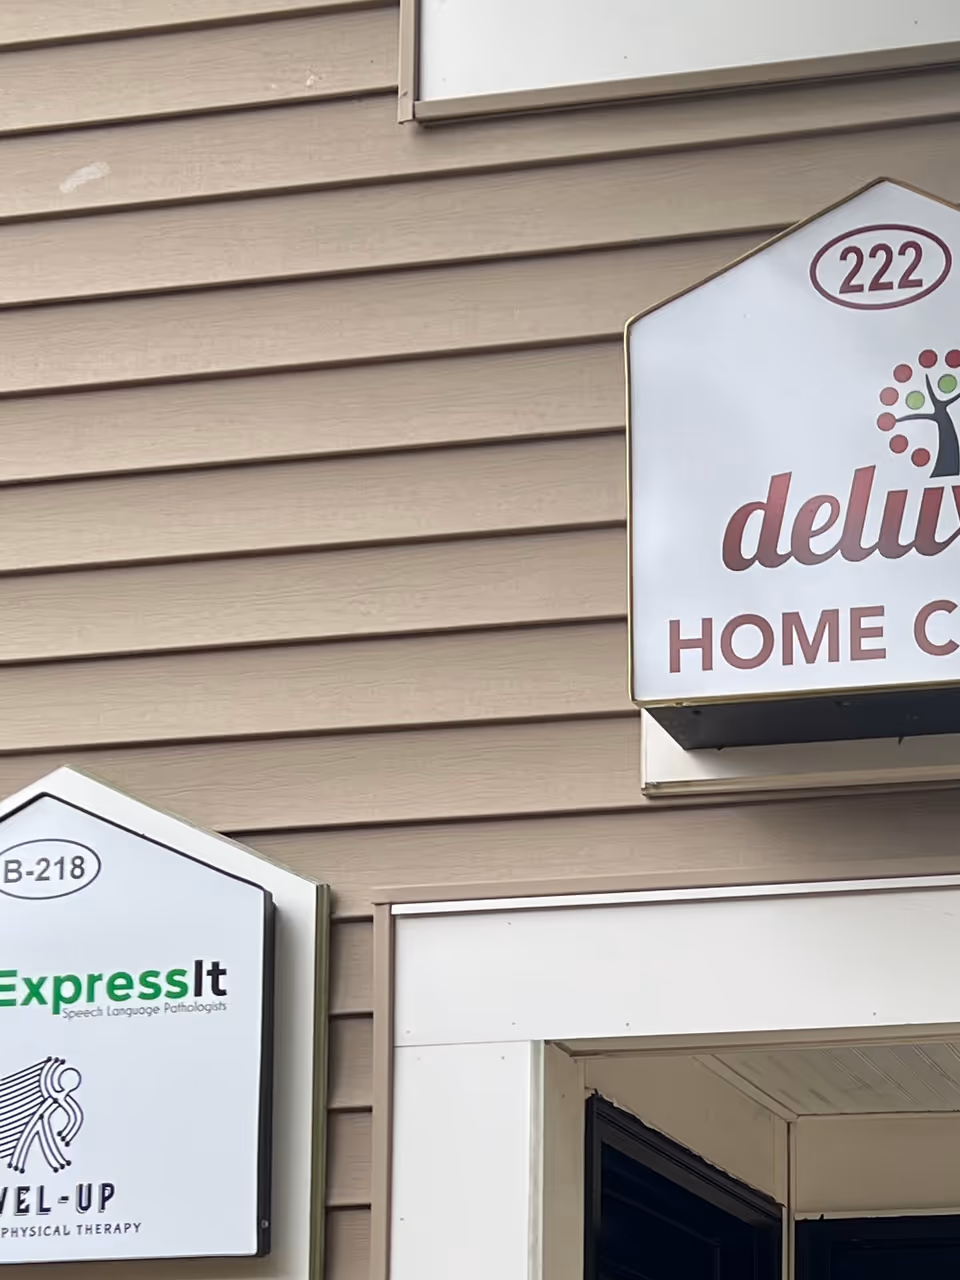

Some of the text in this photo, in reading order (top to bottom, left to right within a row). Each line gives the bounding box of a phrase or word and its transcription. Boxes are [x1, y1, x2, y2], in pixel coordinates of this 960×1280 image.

[838, 240, 924, 295] 222
[668, 605, 887, 674] HOME
[4, 855, 85, 884] B-218
[62, 1000, 228, 1021] Speech Language Pathologists
[1, 1222, 142, 1239] PHYSICAL THERAPY
